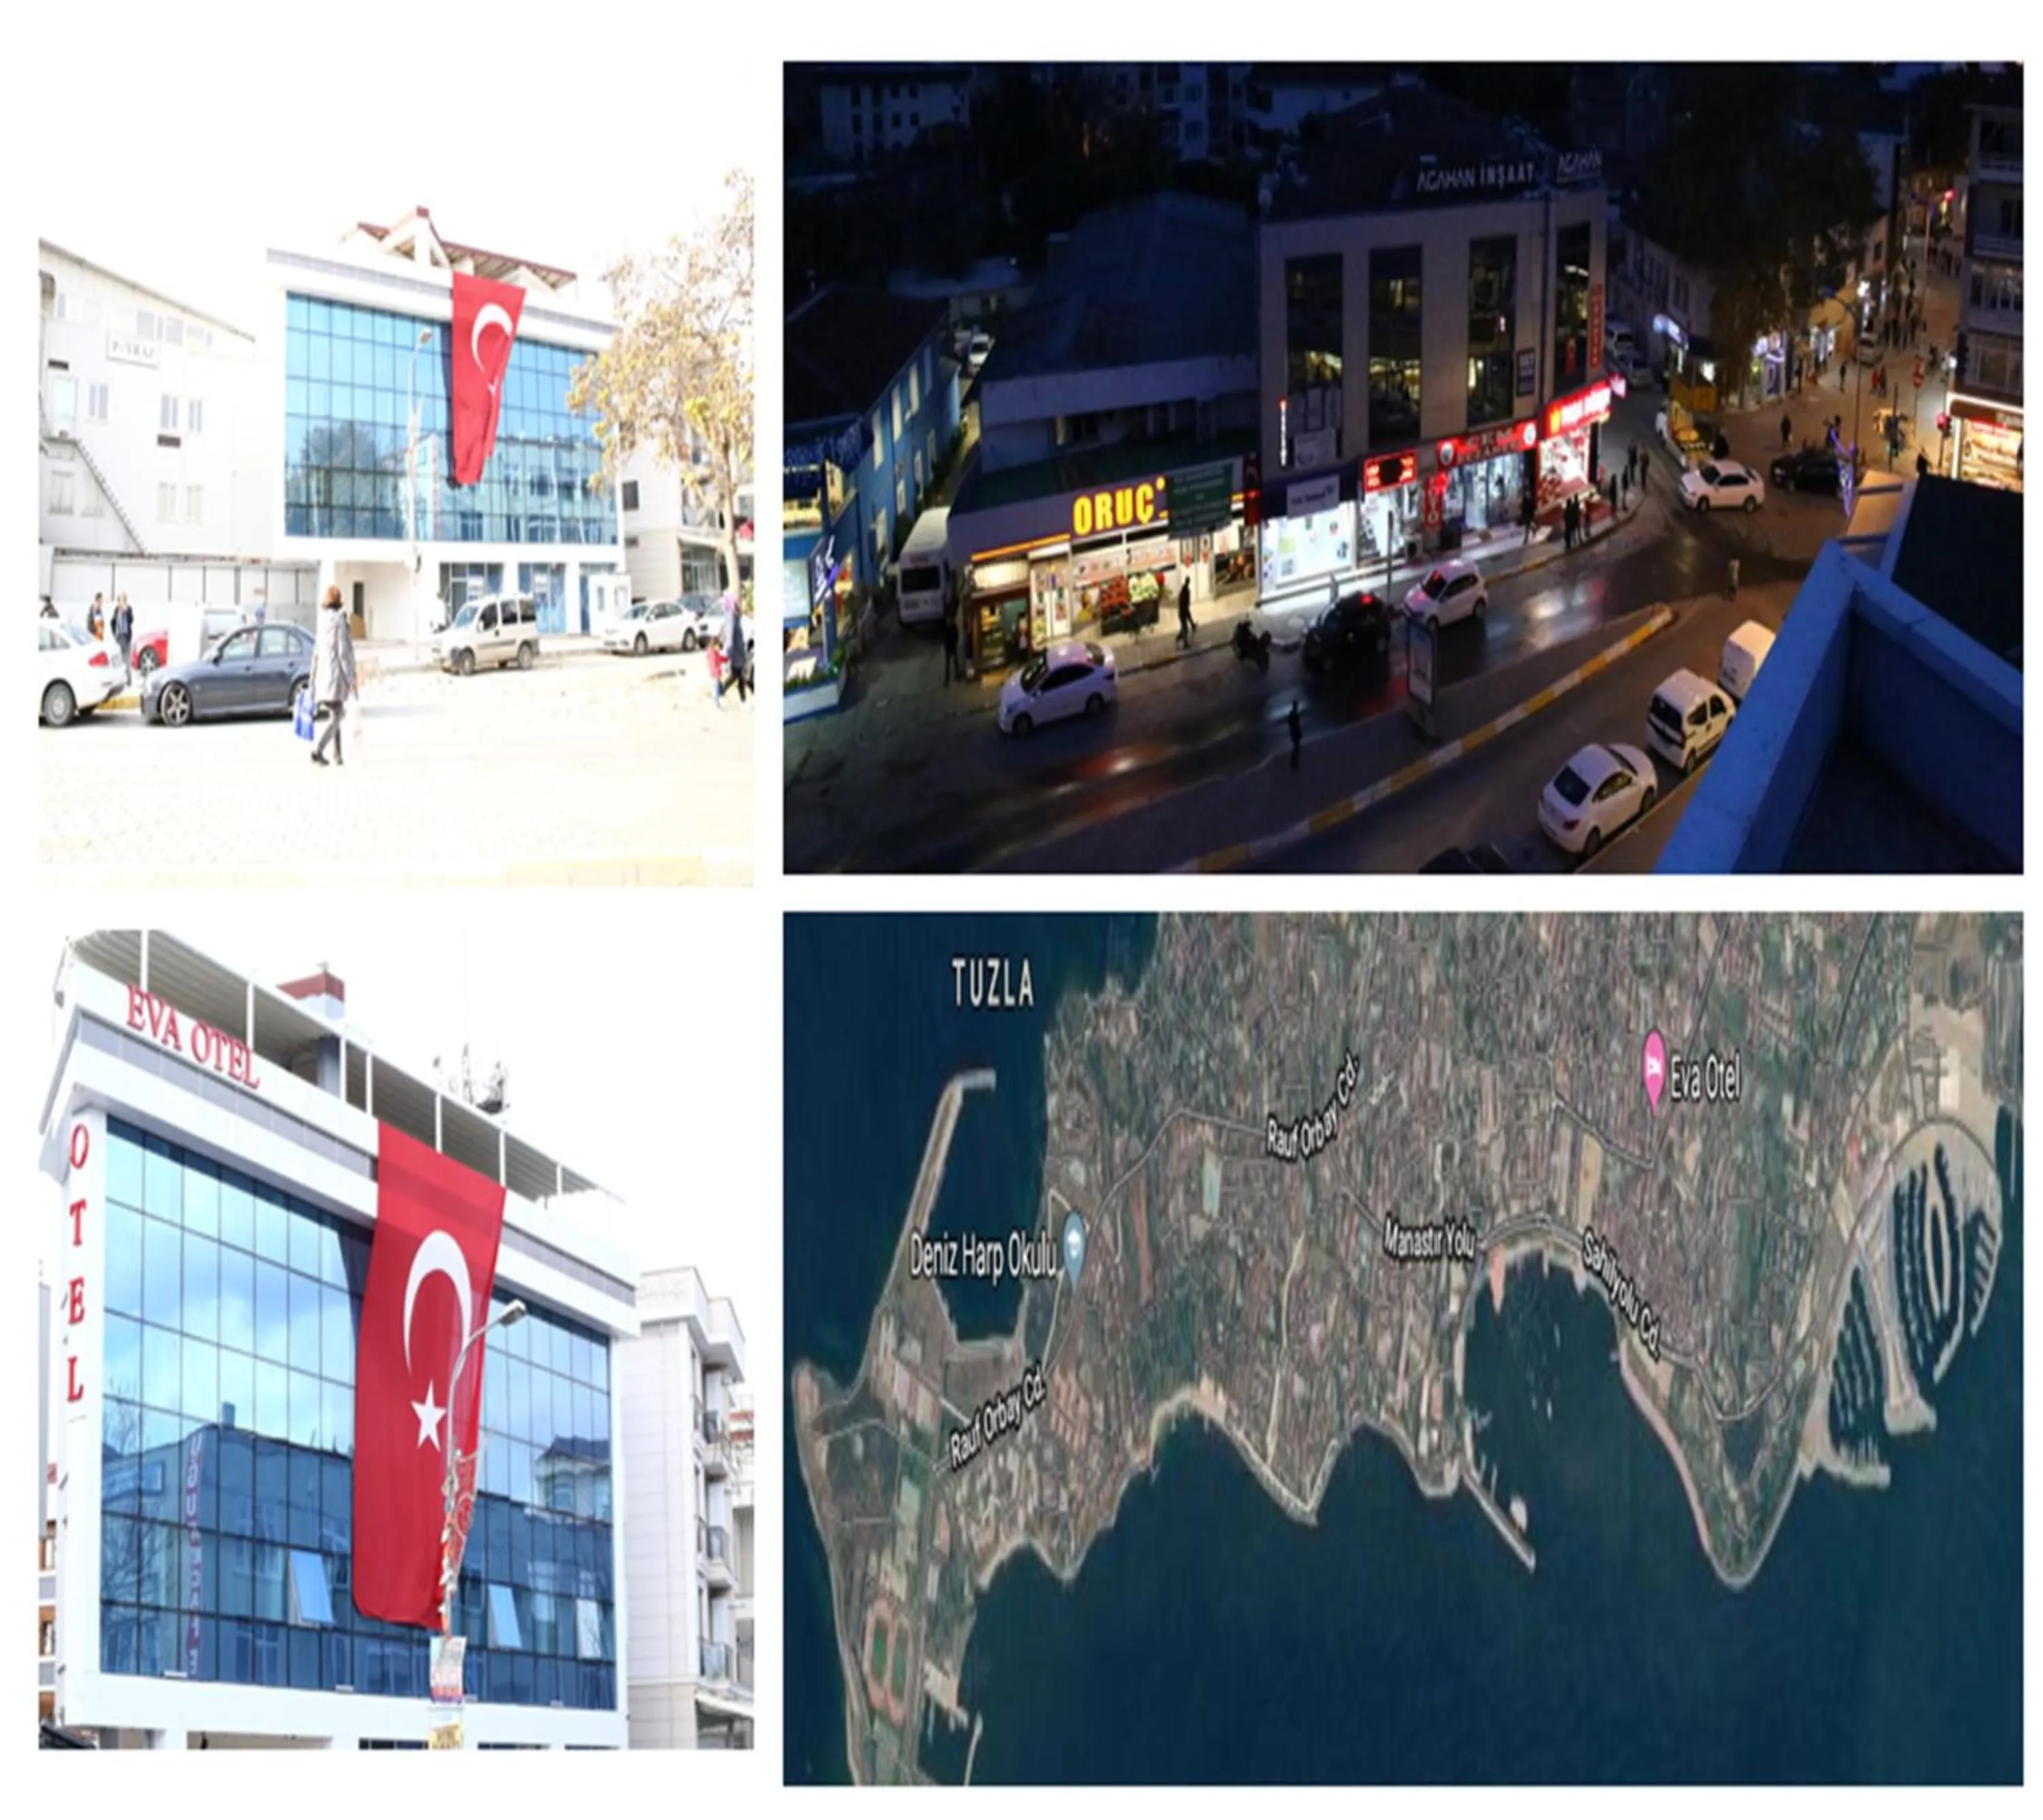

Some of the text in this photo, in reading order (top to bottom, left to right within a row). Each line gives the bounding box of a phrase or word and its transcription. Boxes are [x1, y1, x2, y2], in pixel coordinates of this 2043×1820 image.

[127, 984, 260, 1090] EVA OTEL
[67, 1125, 89, 1402] OTEL
